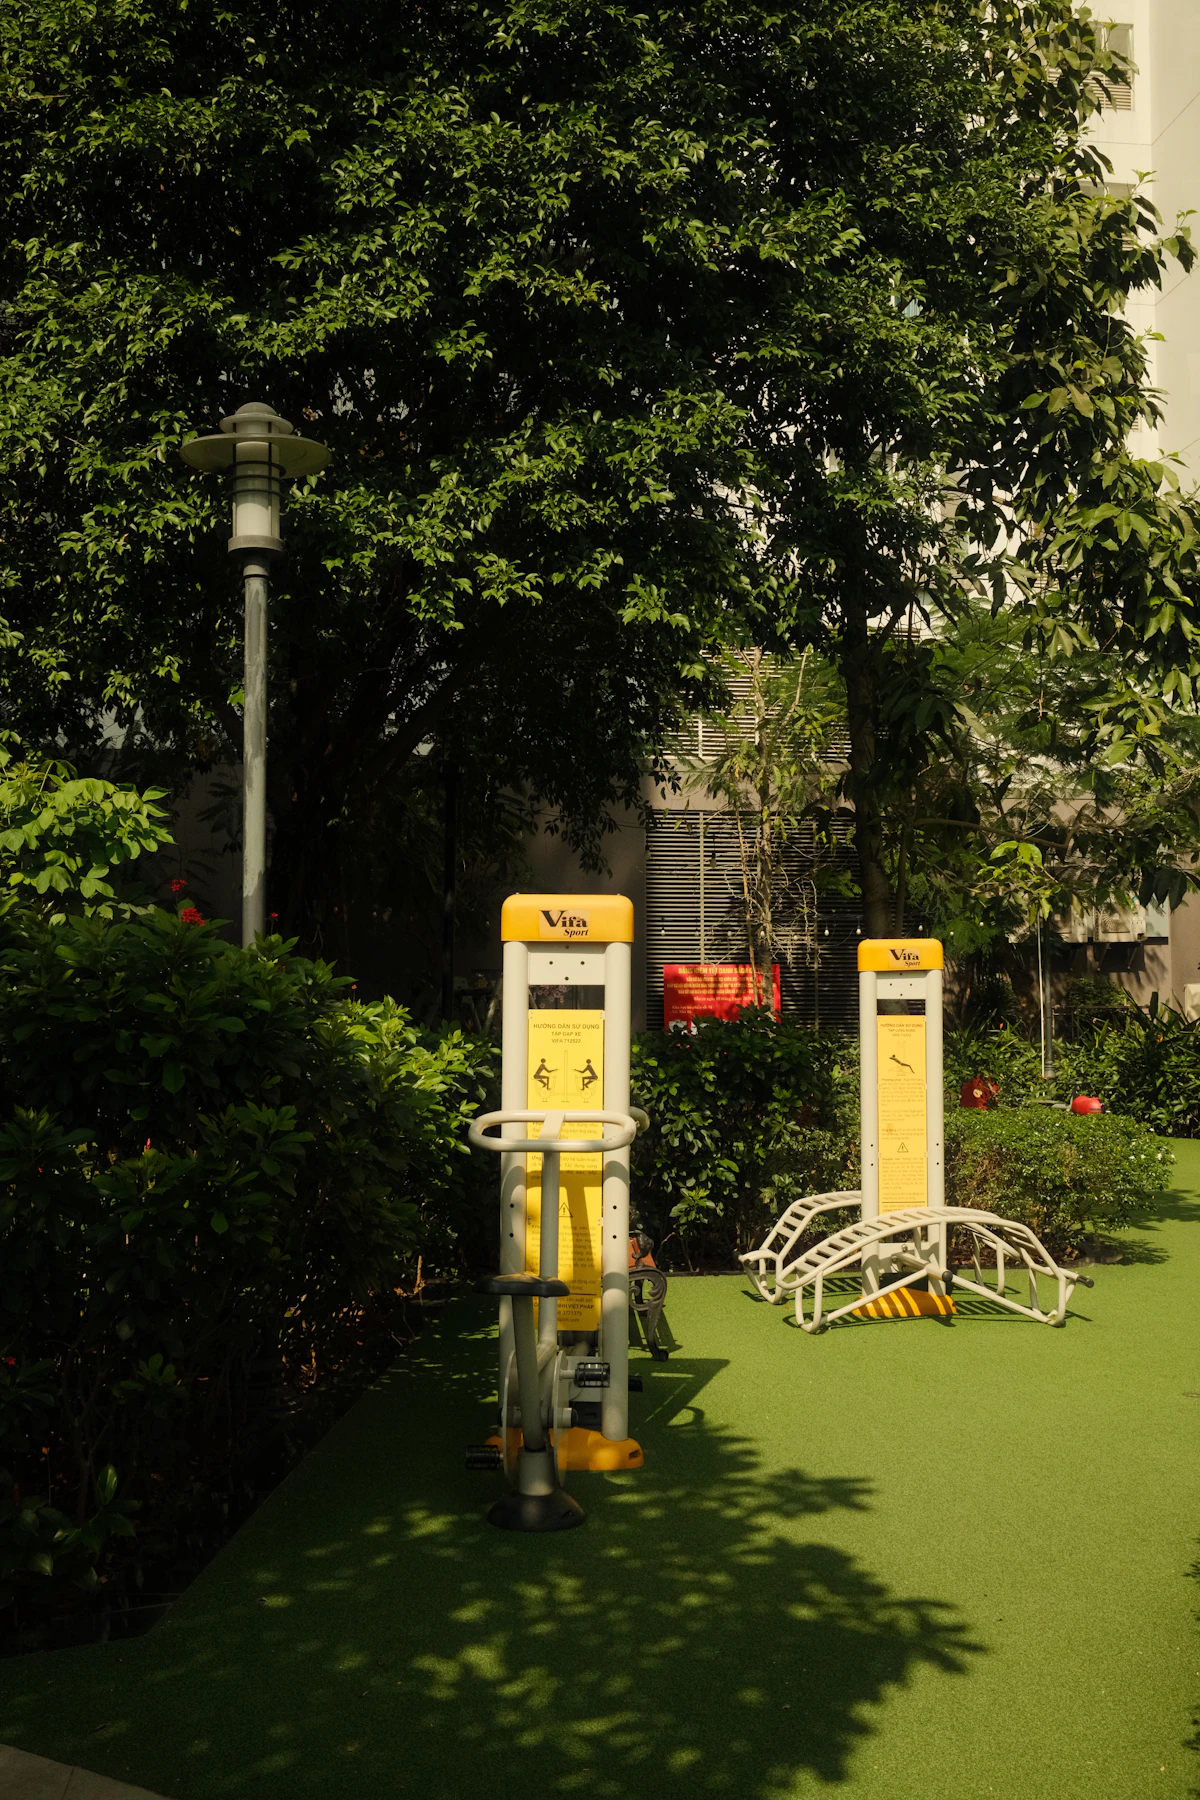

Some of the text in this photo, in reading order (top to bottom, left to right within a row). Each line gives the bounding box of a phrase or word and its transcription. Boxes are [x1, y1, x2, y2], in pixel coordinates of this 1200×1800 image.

[539, 910, 588, 928] Vifa
[563, 928, 588, 938] Sport
[889, 949, 920, 960] Vifa
